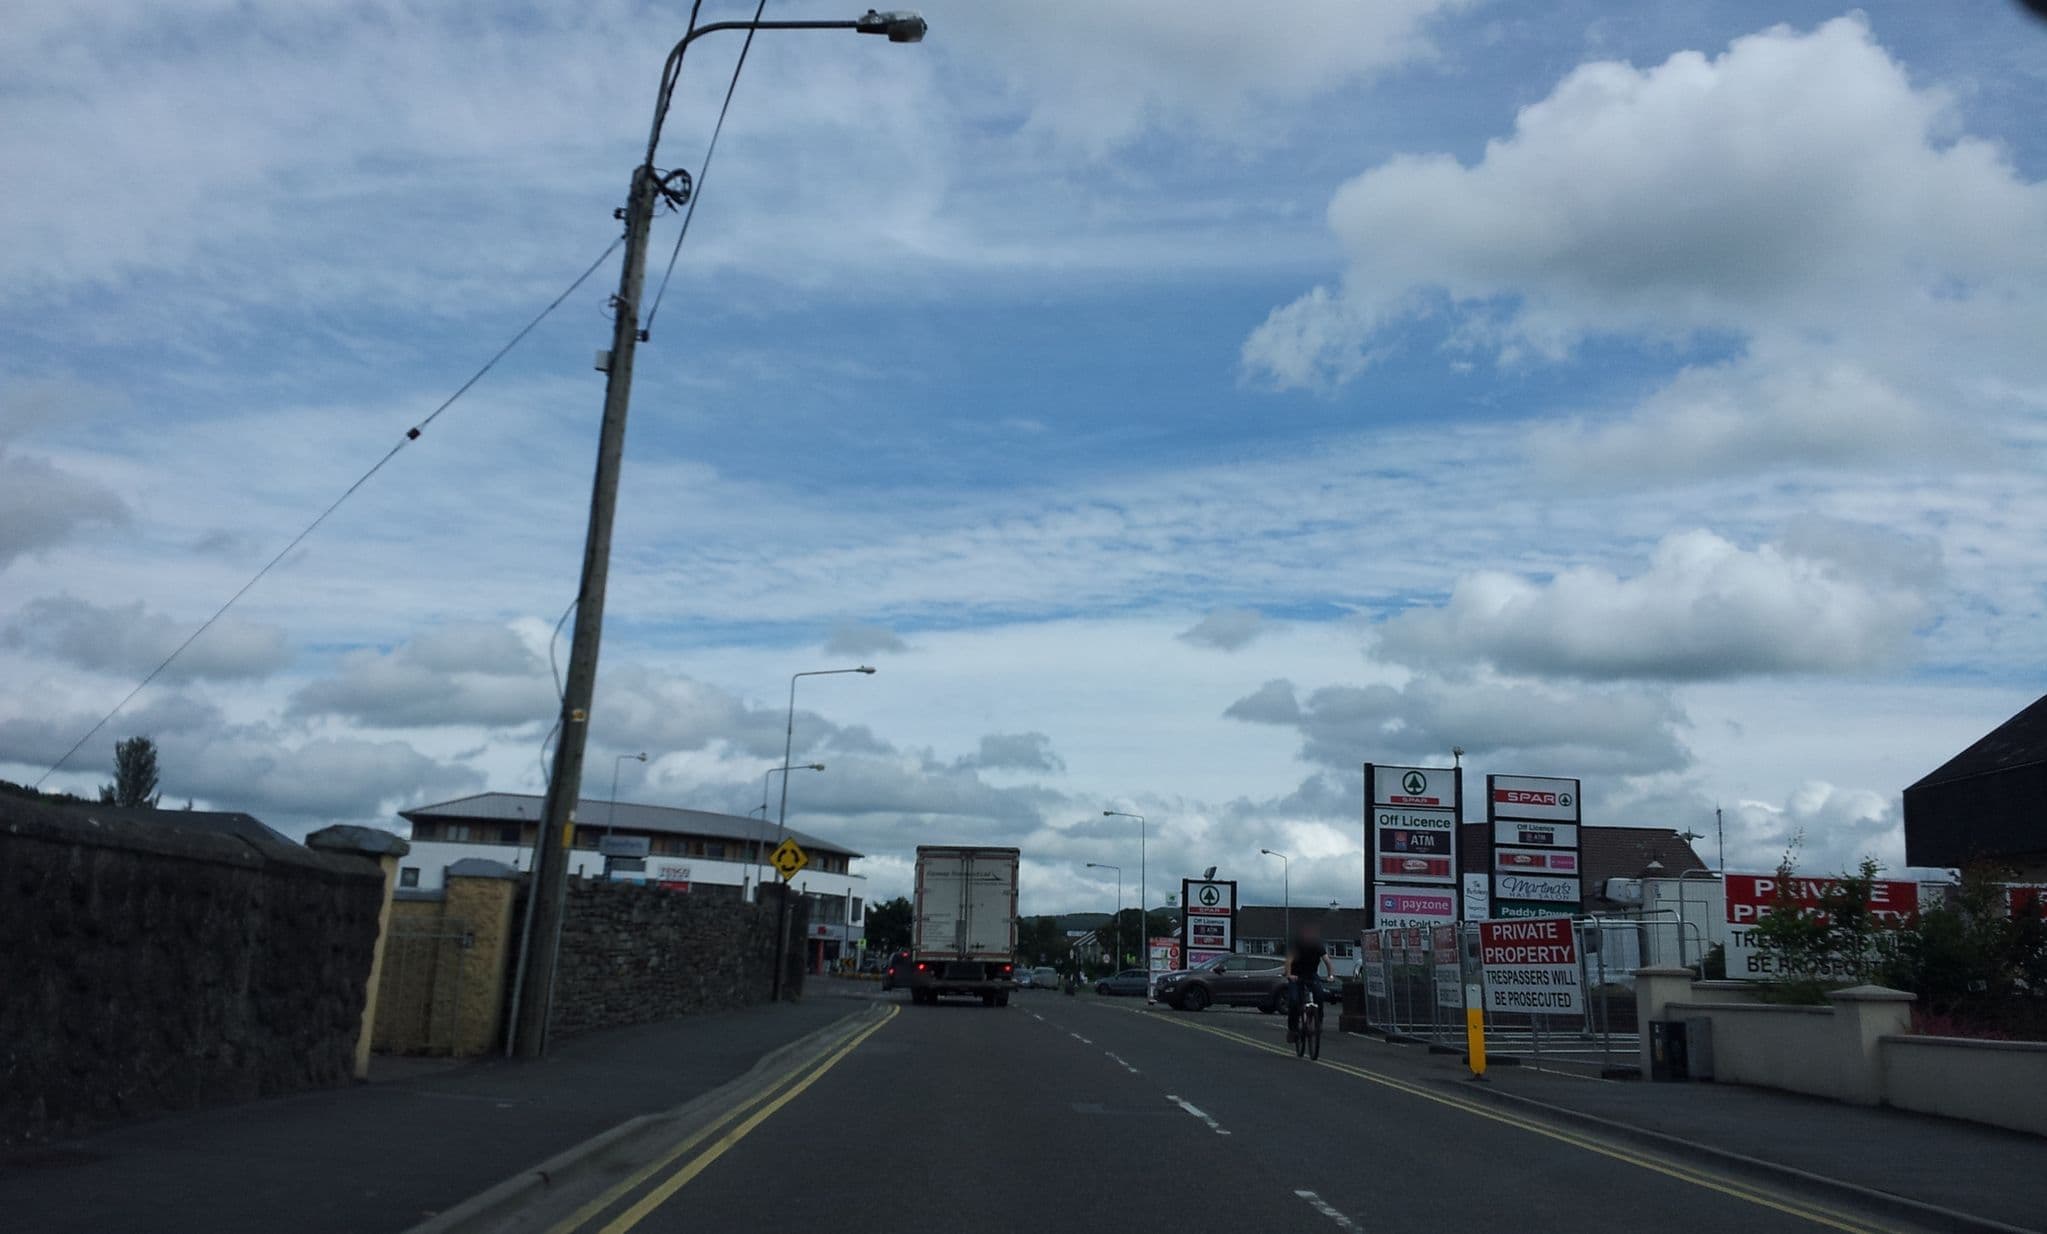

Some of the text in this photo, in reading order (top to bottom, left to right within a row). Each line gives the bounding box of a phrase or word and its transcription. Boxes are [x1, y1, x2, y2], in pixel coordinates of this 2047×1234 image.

[1508, 792, 1555, 804] SPAR
[1380, 814, 1451, 828] Off Licence
[1411, 834, 1435, 846] ATM
[1402, 899, 1449, 912] payzone
[1501, 907, 1536, 918] Paddy
[1381, 918, 1397, 927] Hot
[1493, 922, 1558, 940] PRIVATE
[1485, 945, 1571, 963] PROPERTY
[1747, 955, 1772, 973] BE
[1486, 970, 1577, 986] TRESPASSERS WILL
[1494, 991, 1571, 1008] BE PROSECUTED
